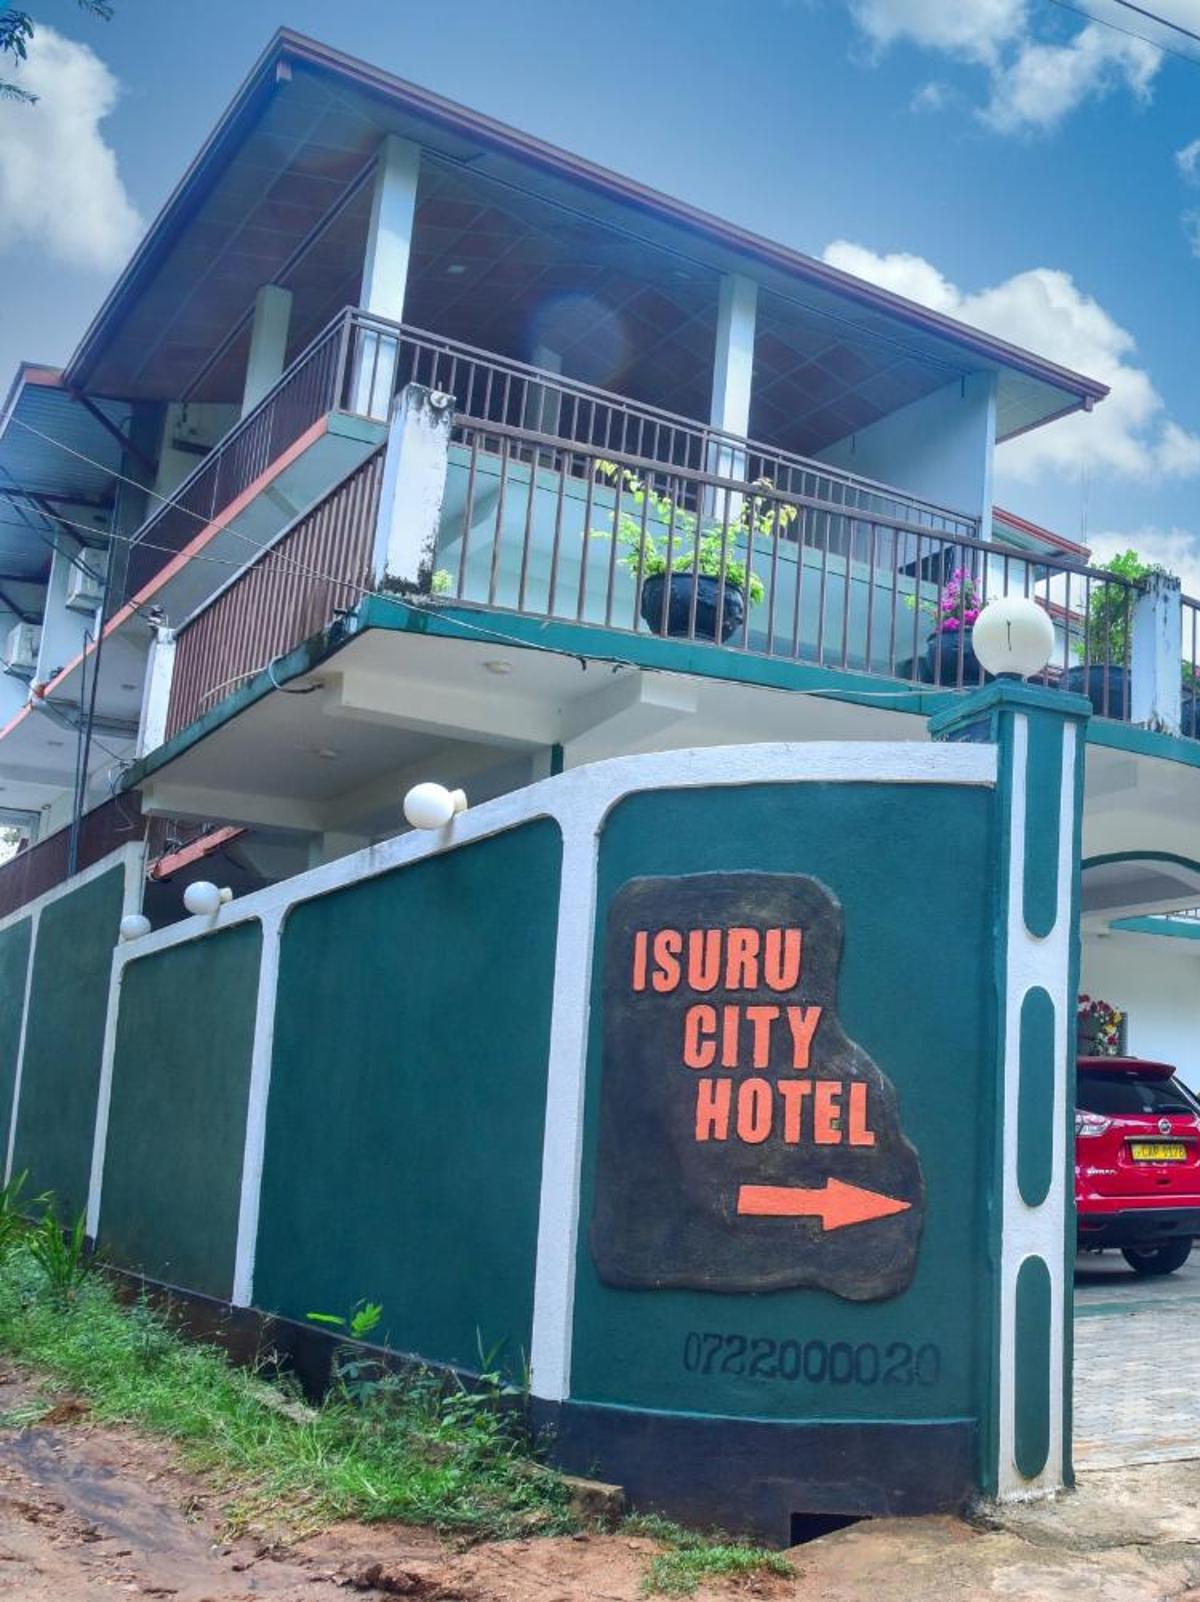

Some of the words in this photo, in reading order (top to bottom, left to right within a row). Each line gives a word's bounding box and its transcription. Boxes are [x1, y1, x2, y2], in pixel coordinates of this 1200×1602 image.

[633, 928, 802, 992] ISURU
[683, 1004, 822, 1069] CITY
[695, 1078, 876, 1146] HOTEL
[683, 1331, 942, 1387] 0722000020
